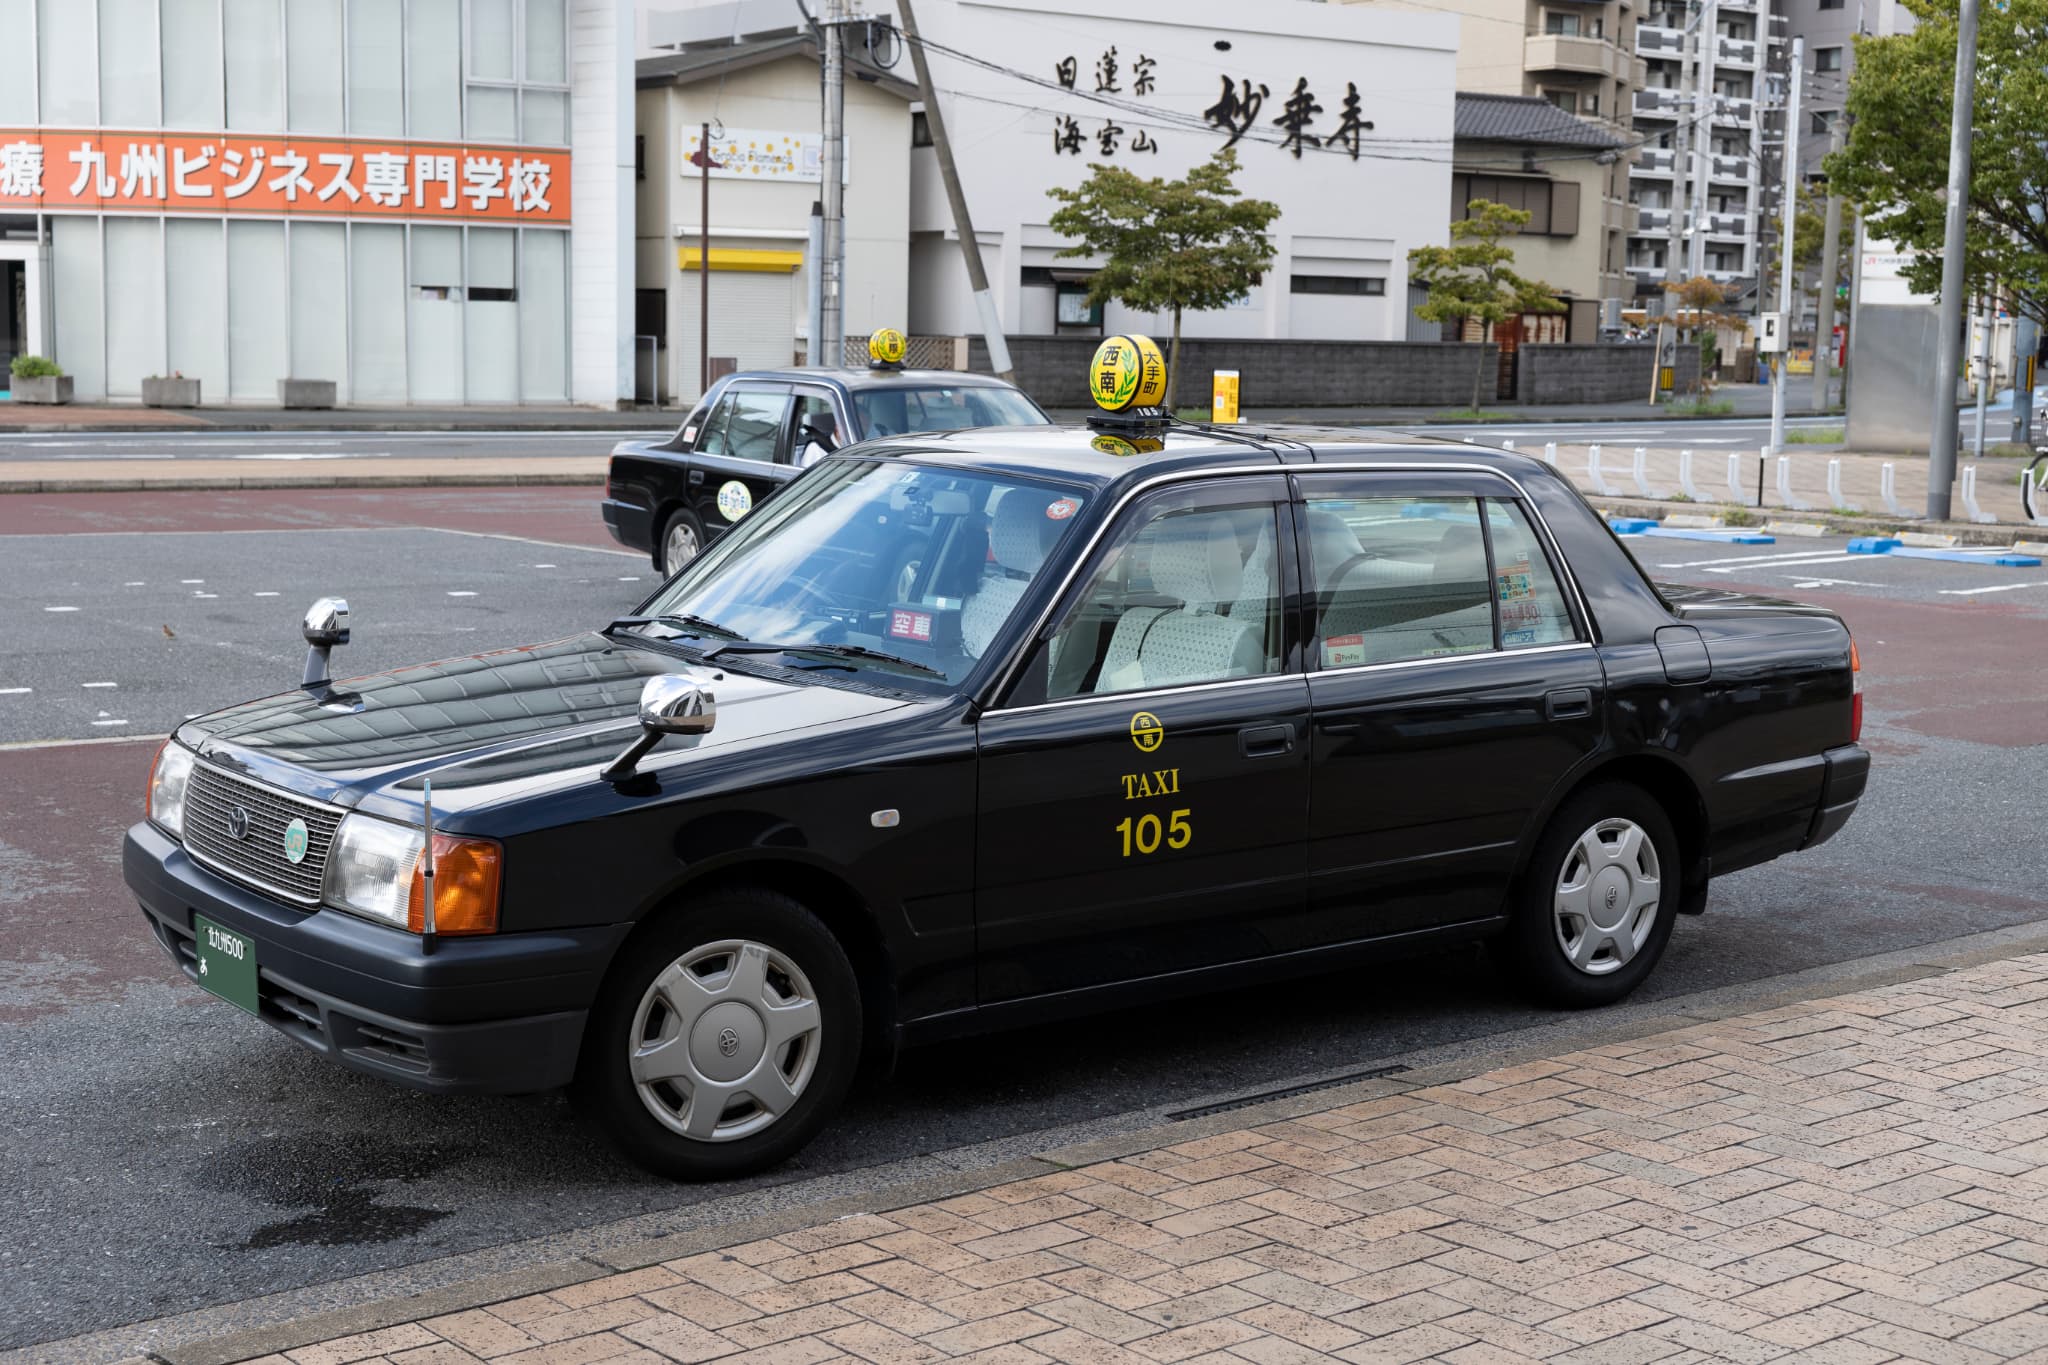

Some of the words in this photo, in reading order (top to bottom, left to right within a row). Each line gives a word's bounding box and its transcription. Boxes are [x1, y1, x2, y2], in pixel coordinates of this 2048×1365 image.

[1055, 45, 1157, 96] 日蓮宗
[68, 141, 552, 213] 九州ビジネス専門学校
[1100, 345, 1121, 394] 西南
[1142, 351, 1161, 395] 大手町
[1137, 407, 1158, 417] 105
[892, 612, 931, 637] 空車
[1121, 768, 1181, 800] TAXI
[1116, 808, 1192, 857] 105
[200, 956, 208, 977] あ
